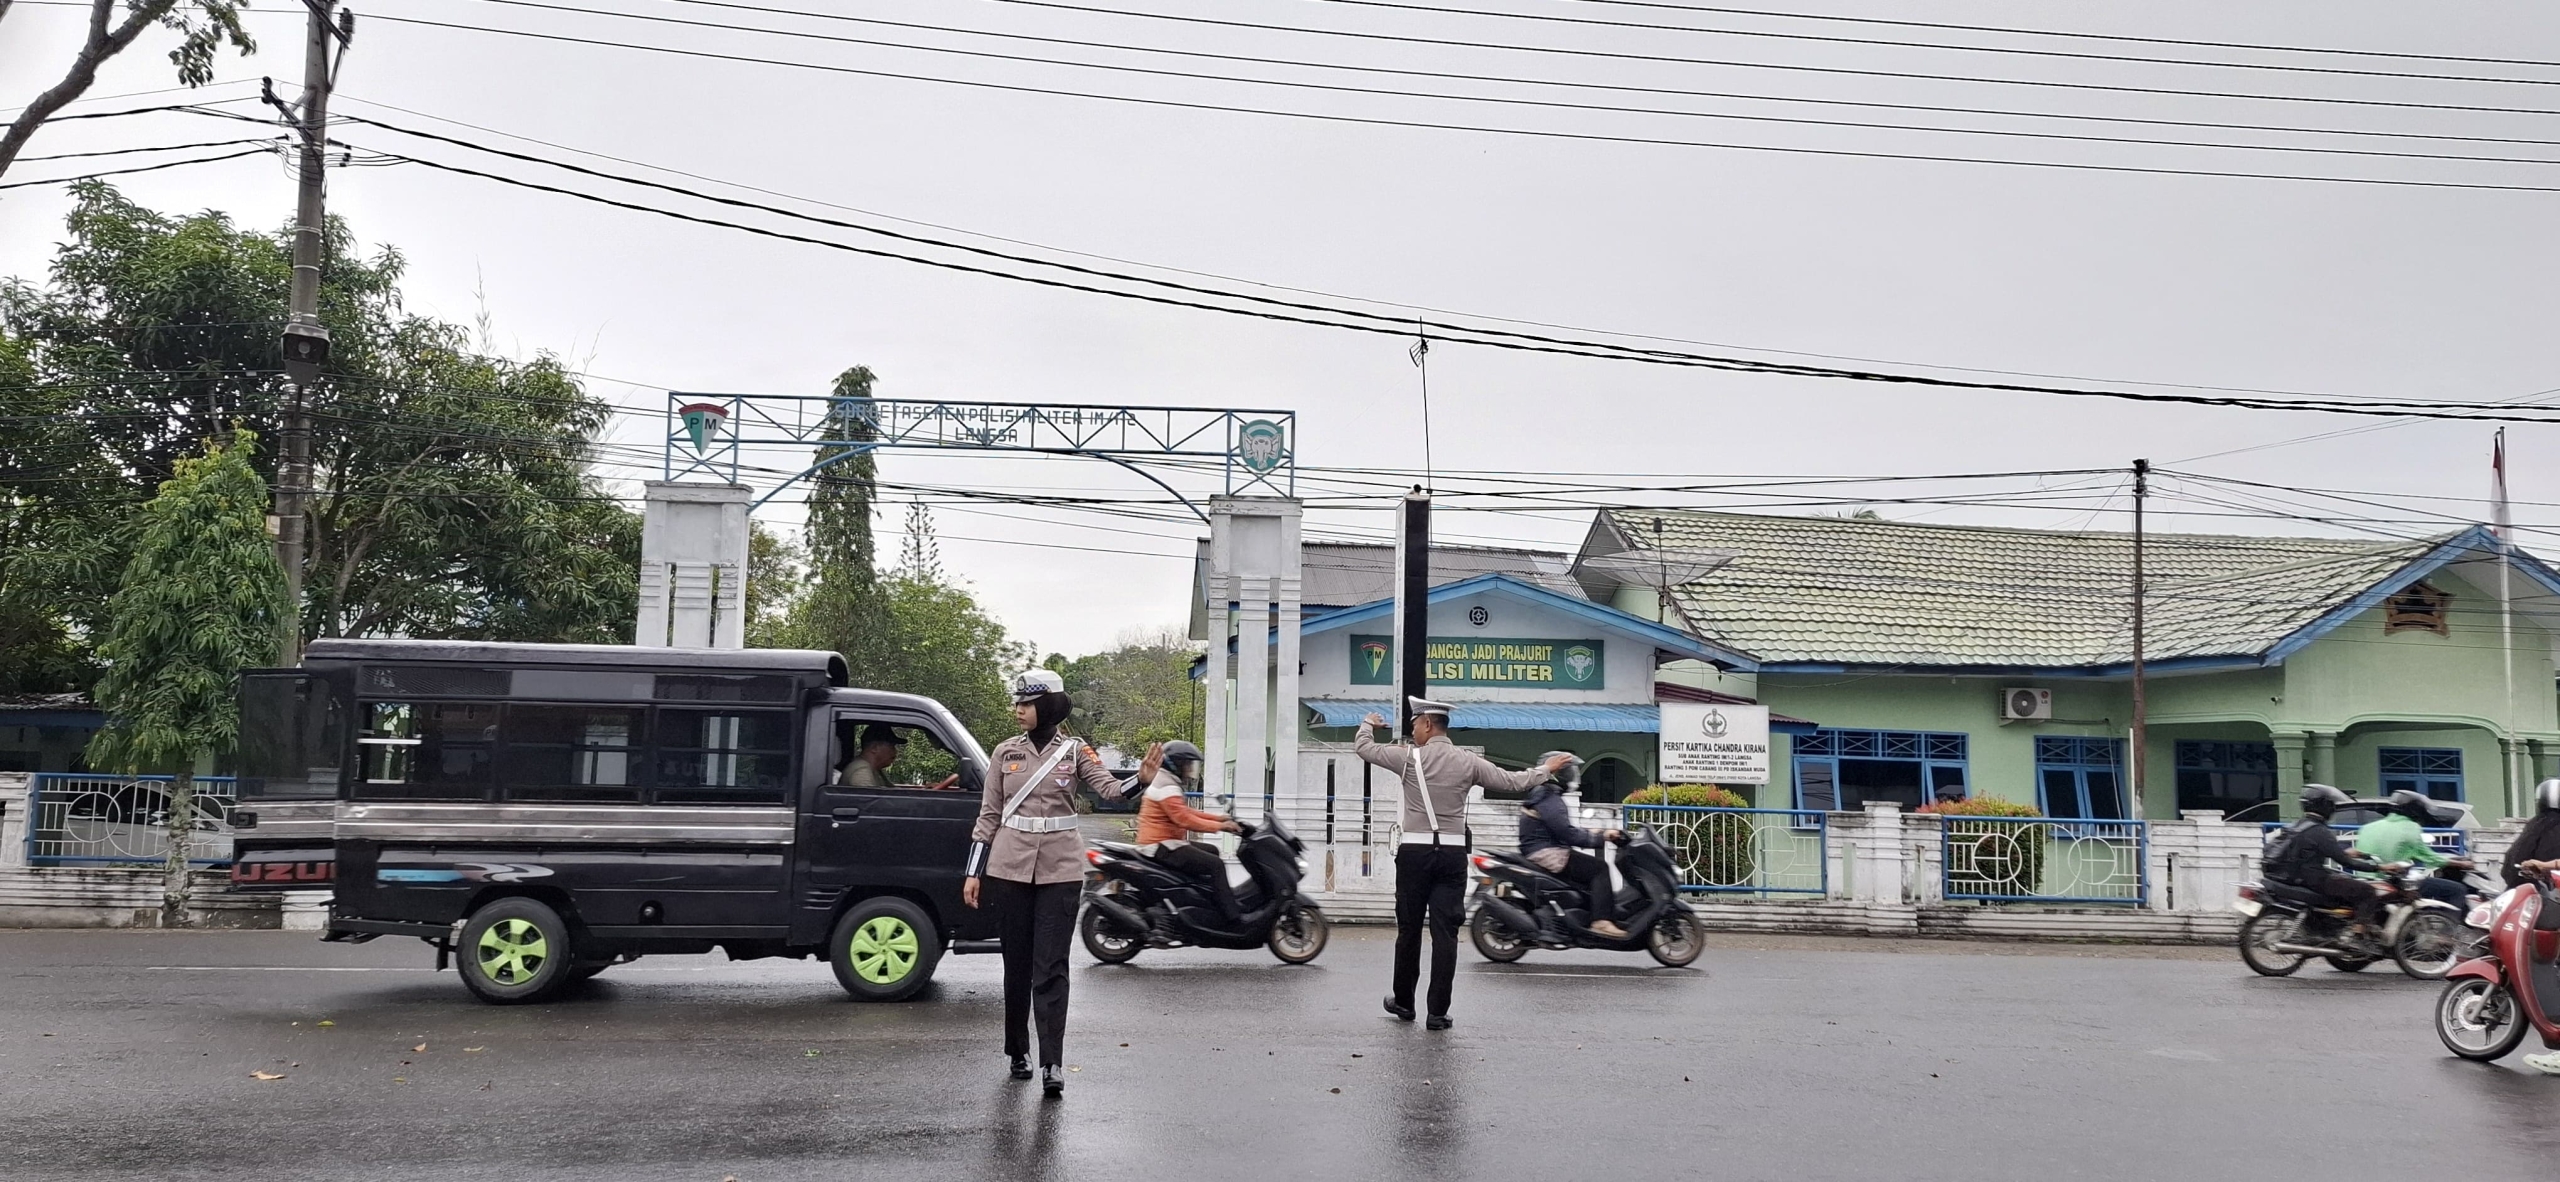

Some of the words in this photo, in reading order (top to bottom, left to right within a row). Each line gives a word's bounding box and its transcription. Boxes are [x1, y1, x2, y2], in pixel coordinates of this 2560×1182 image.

[1471, 643, 1497, 660] JADI
[1499, 644, 1553, 662] PRAJURIT
[1471, 663, 1553, 682] MILITER
[1663, 742, 1684, 752] PERSIT
[1686, 742, 1713, 753] KARTIKA
[1713, 742, 1743, 754] CHANDRA
[1744, 743, 1766, 754] KIRANA
